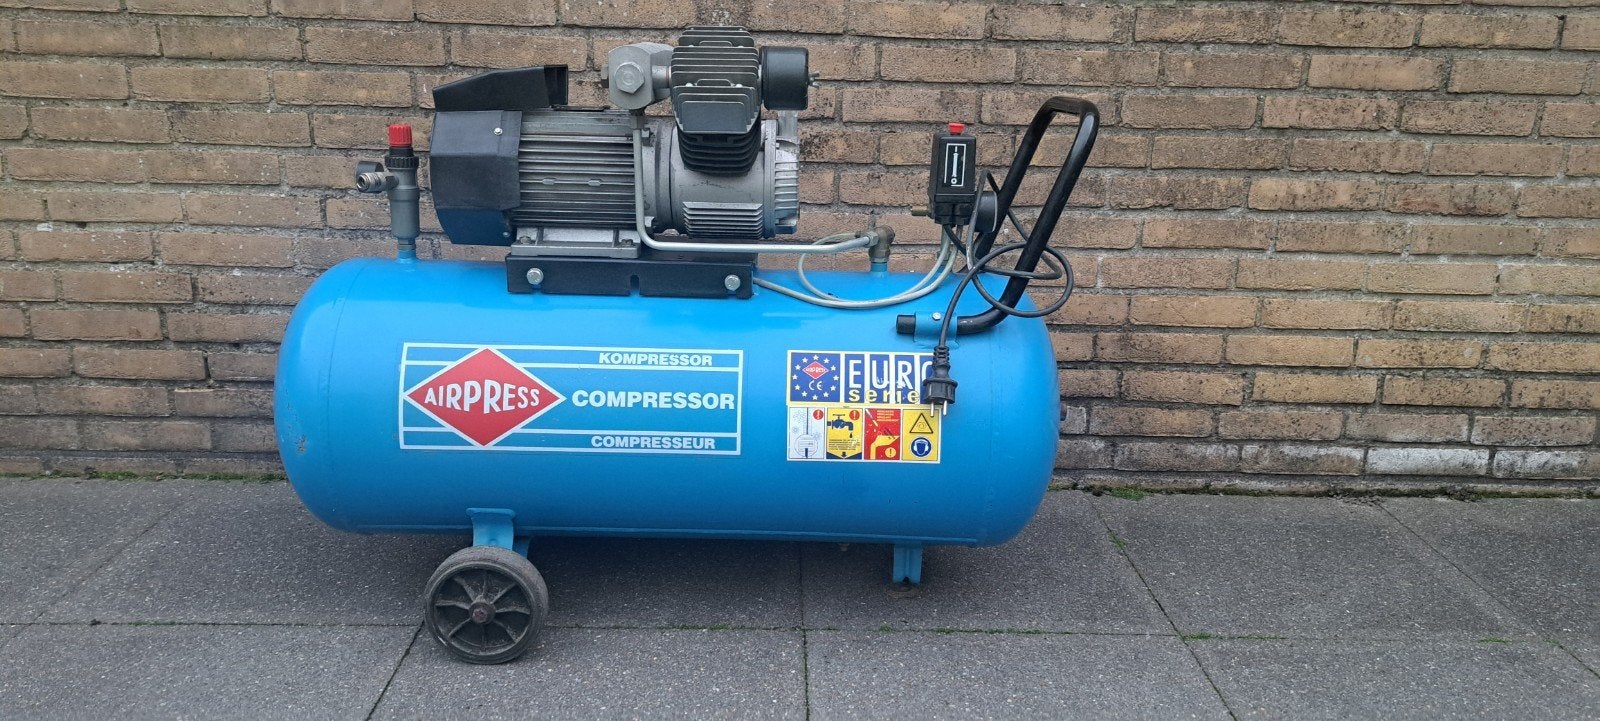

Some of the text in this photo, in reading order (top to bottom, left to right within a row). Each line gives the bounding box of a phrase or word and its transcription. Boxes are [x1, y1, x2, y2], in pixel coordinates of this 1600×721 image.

[599, 353, 713, 366] KOMPRESSOR
[808, 380, 823, 391] CE
[424, 379, 540, 414] AIRPRESS
[572, 390, 735, 410] COMPRESSOR
[848, 388, 921, 404] serie
[591, 436, 716, 450] COMPRESSEUR
